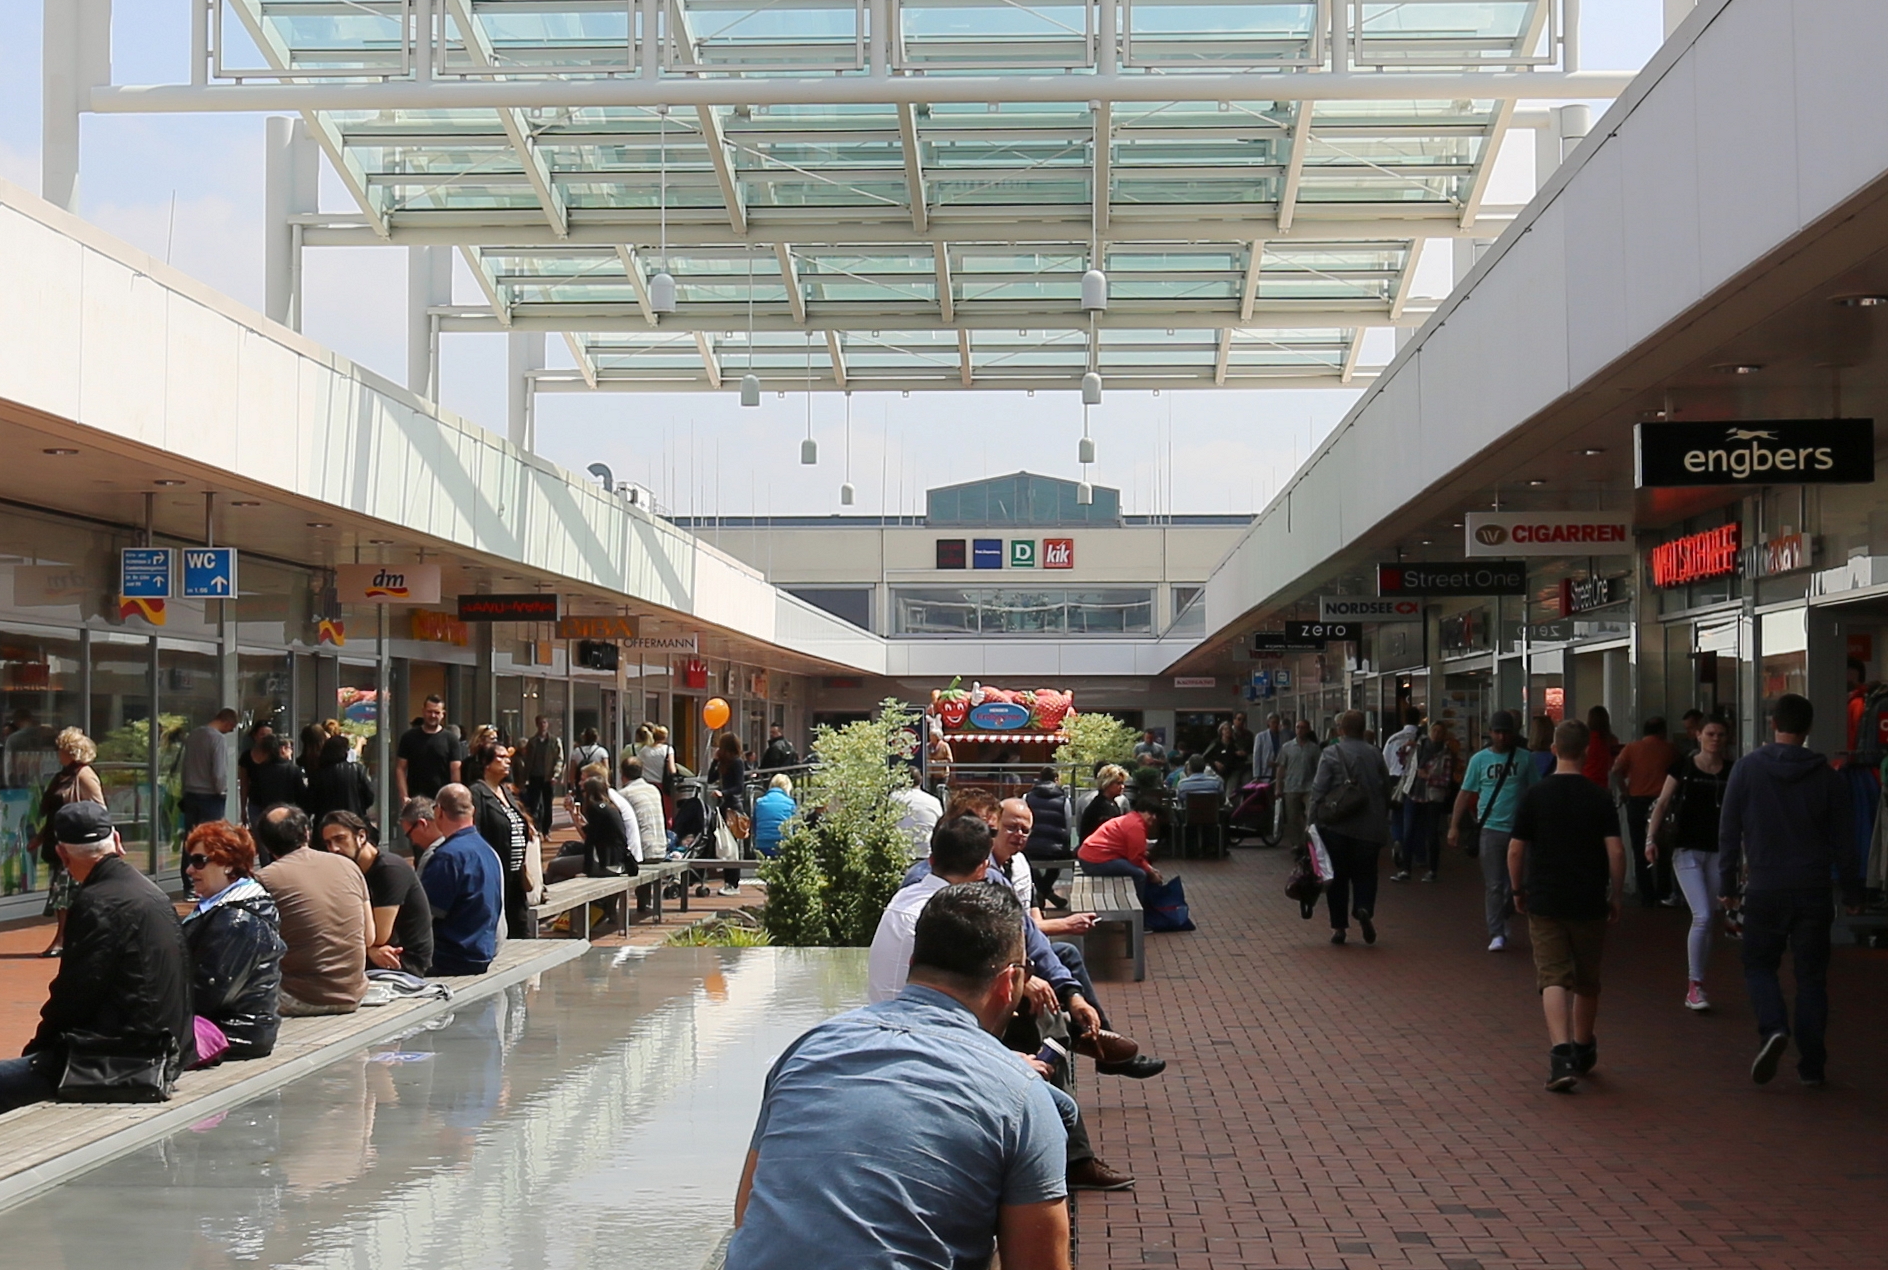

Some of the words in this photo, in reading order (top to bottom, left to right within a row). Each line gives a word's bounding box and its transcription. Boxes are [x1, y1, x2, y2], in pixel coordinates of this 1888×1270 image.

[1683, 441, 1834, 479] engbers
[1512, 525, 1625, 543] CIGARREN
[1015, 543, 1031, 560] D
[186, 553, 216, 569] WC
[372, 568, 405, 588] dm
[1403, 570, 1471, 588] Street
[1475, 570, 1520, 587] One
[1325, 602, 1393, 615] NORDSEE
[1301, 625, 1346, 637] zero
[623, 638, 695, 649] OFFERMANN
